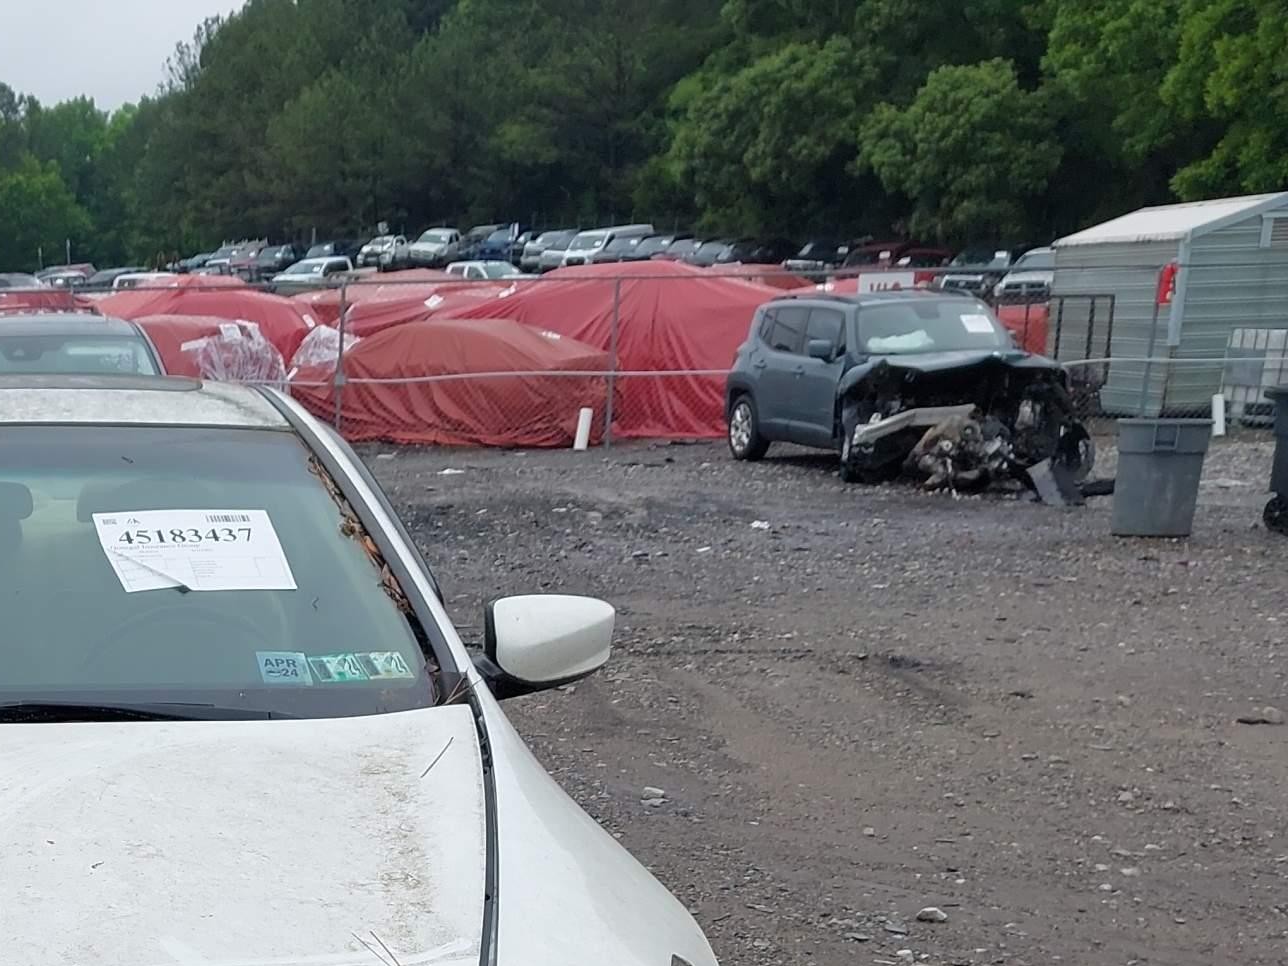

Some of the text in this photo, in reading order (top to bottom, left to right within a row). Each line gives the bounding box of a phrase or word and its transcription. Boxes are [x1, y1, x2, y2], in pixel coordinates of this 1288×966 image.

[119, 527, 252, 544] 45183437
[264, 658, 297, 668] APR
[281, 668, 298, 677] 24
